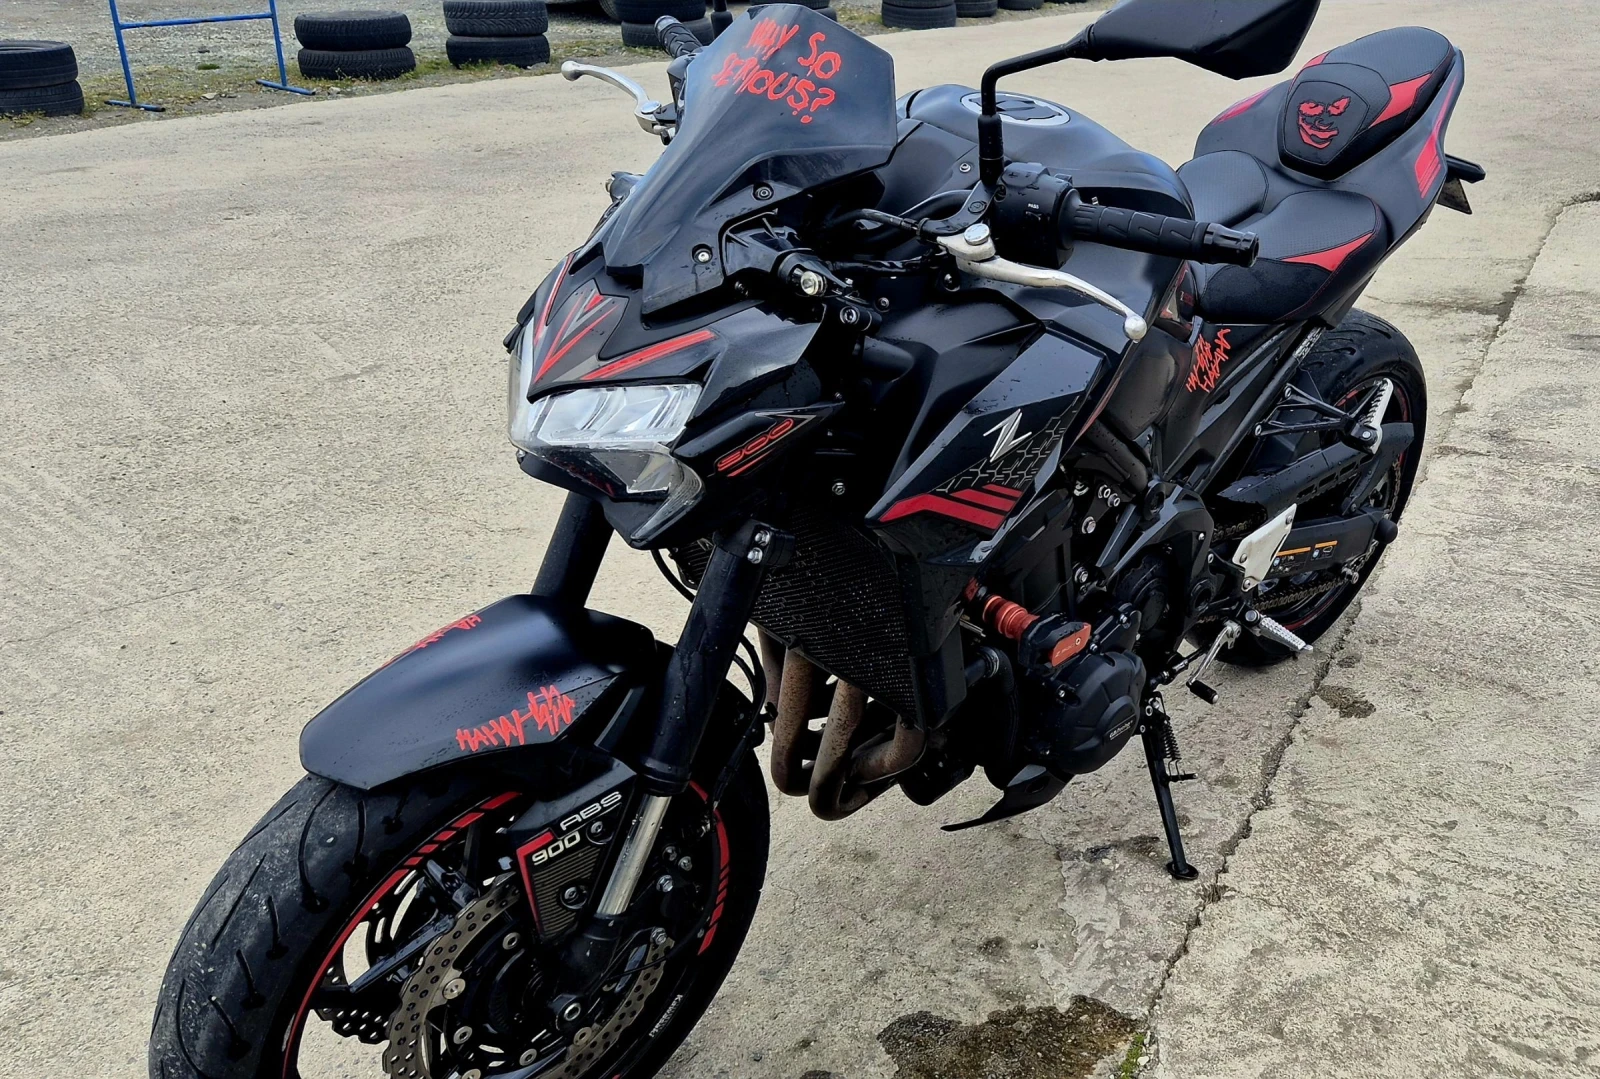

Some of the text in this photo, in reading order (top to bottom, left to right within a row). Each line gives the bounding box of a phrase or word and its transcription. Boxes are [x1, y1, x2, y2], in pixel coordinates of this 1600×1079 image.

[798, 32, 841, 79] SO
[717, 418, 794, 472] 900
[983, 408, 1032, 463] Z
[531, 791, 622, 866] 900 ABS
